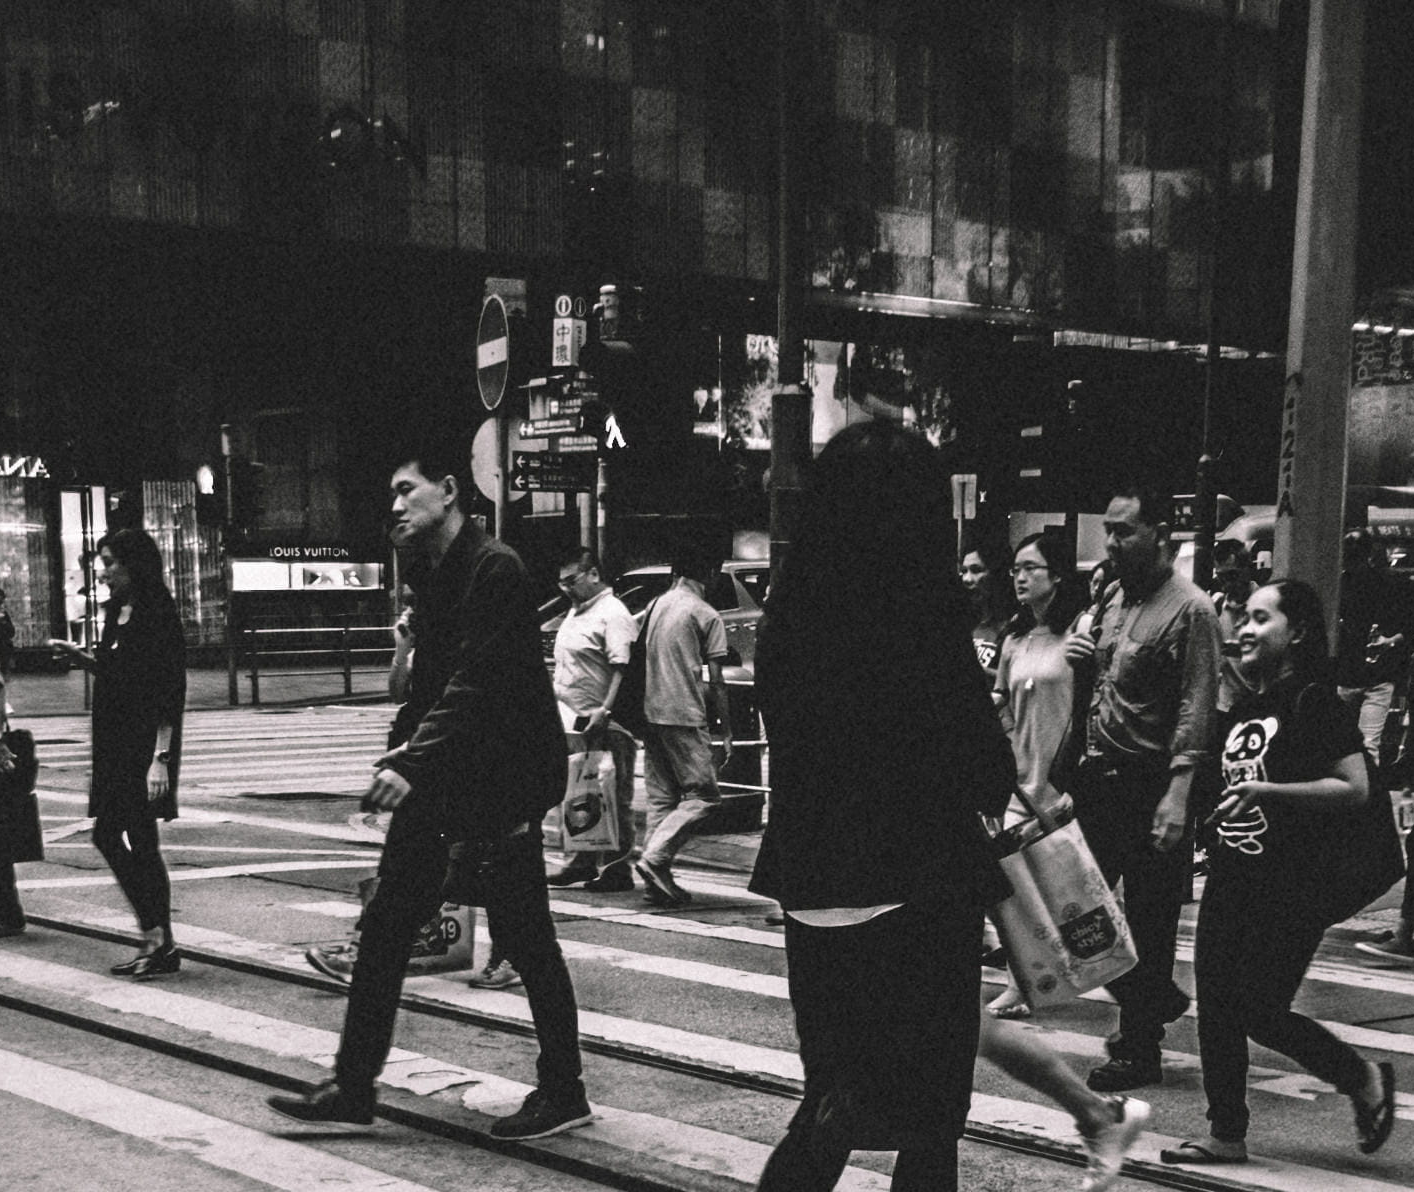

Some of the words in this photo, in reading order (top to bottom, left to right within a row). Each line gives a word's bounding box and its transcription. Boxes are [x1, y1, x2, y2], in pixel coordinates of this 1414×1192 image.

[269, 547, 301, 557] LOUIS
[303, 547, 349, 557] VUITTON
[439, 921, 457, 939] 19
